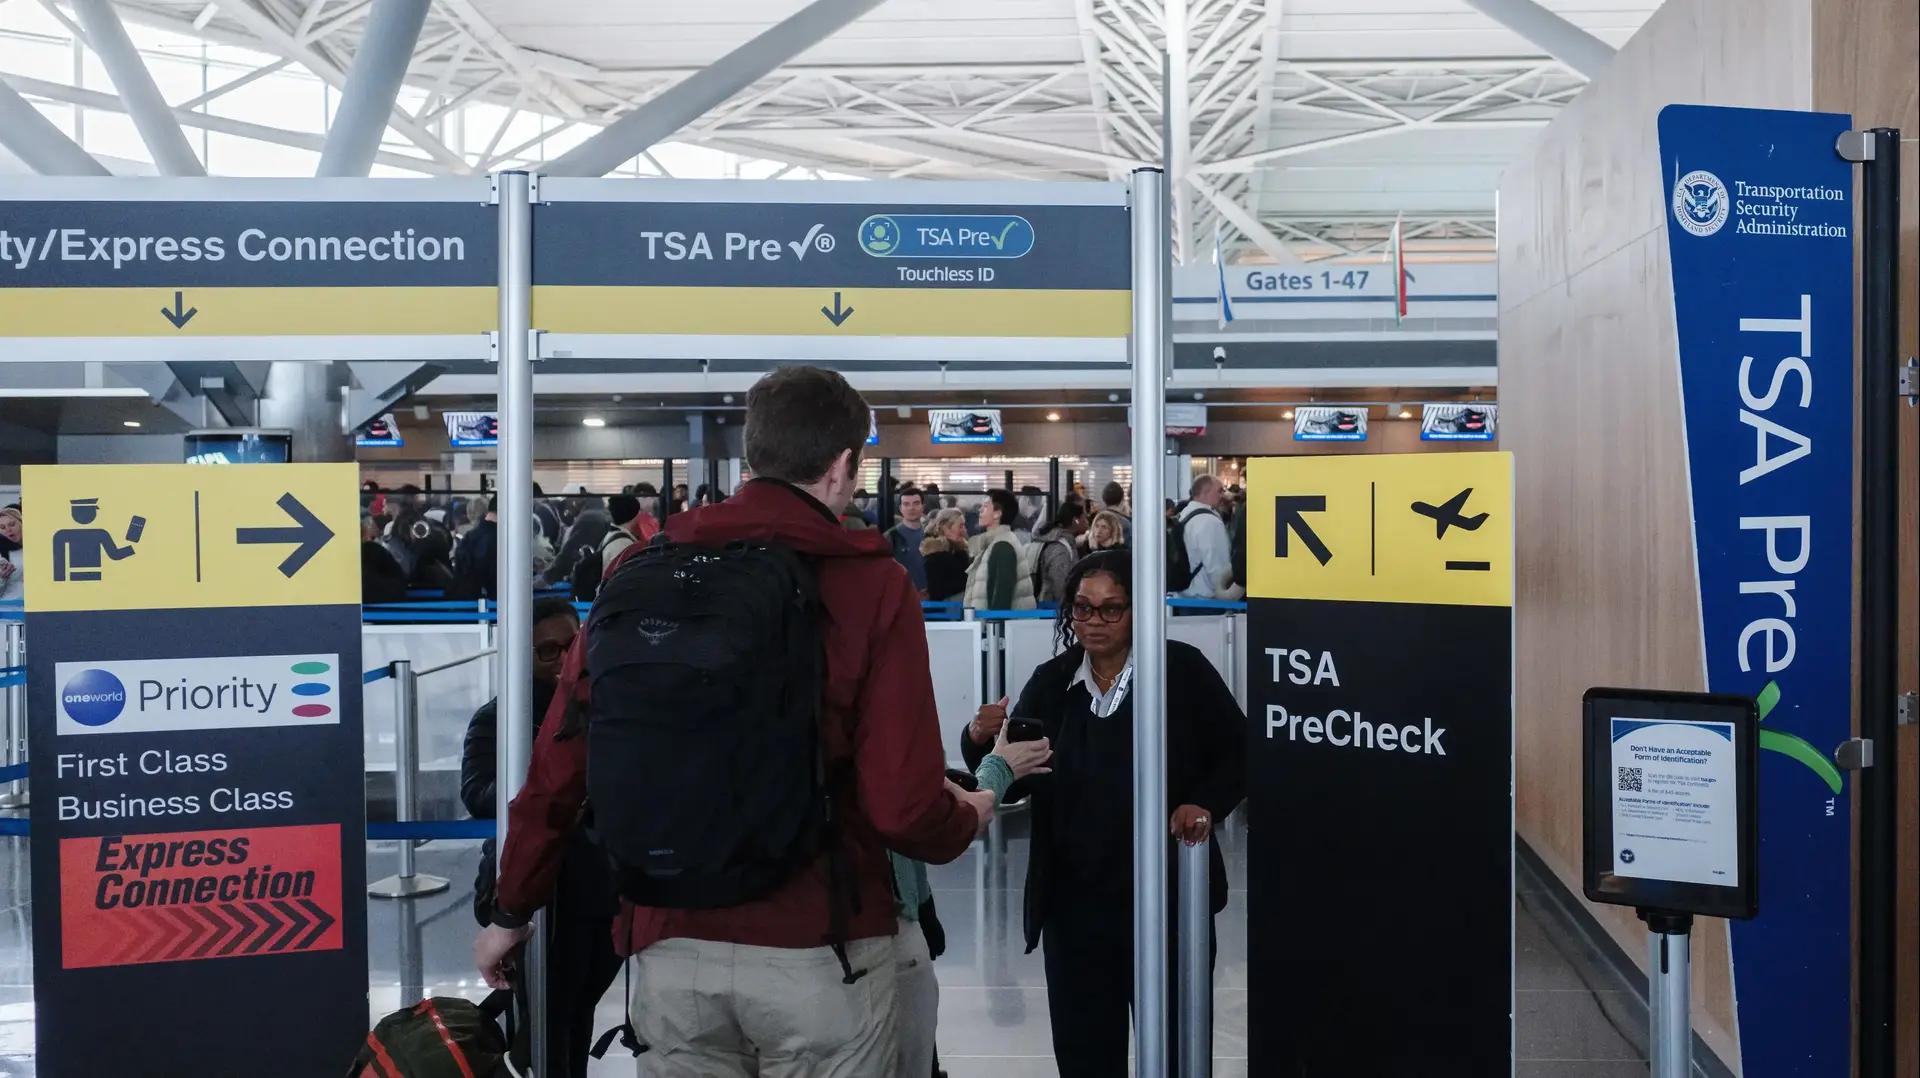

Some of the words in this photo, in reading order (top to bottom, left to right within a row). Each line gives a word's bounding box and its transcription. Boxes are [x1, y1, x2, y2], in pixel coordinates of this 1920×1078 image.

[1734, 180, 1844, 203] Transportation
[1676, 205, 1704, 233] HOMELAND
[1704, 208, 1727, 233] SECURITY
[1736, 199, 1799, 222] Security
[916, 228, 954, 246] TSA
[1735, 218, 1847, 238] Administration
[237, 228, 466, 262] Connection
[640, 231, 714, 261] TSA
[896, 266, 974, 282] Touchless
[978, 267, 995, 282] ID
[1246, 271, 1313, 291] Gates
[1321, 270, 1370, 290] 1-47
[1738, 294, 1813, 486] TSA
[1737, 515, 1811, 673] Pre
[1264, 647, 1341, 687] TSA
[64, 691, 123, 703] oneworld
[139, 676, 278, 714] Priority
[1266, 704, 1447, 756] PreCheck
[57, 752, 129, 779] First
[139, 749, 228, 775] Class
[1630, 744, 1647, 753] Don't
[1648, 746, 1666, 754] Have
[1676, 747, 1712, 757] Acceptable
[1634, 753, 1652, 761] Form
[1660, 755, 1708, 765] Identification?
[58, 793, 201, 821] Business
[209, 787, 294, 812] Class
[95, 836, 250, 878] Express
[95, 865, 315, 910] Connection
